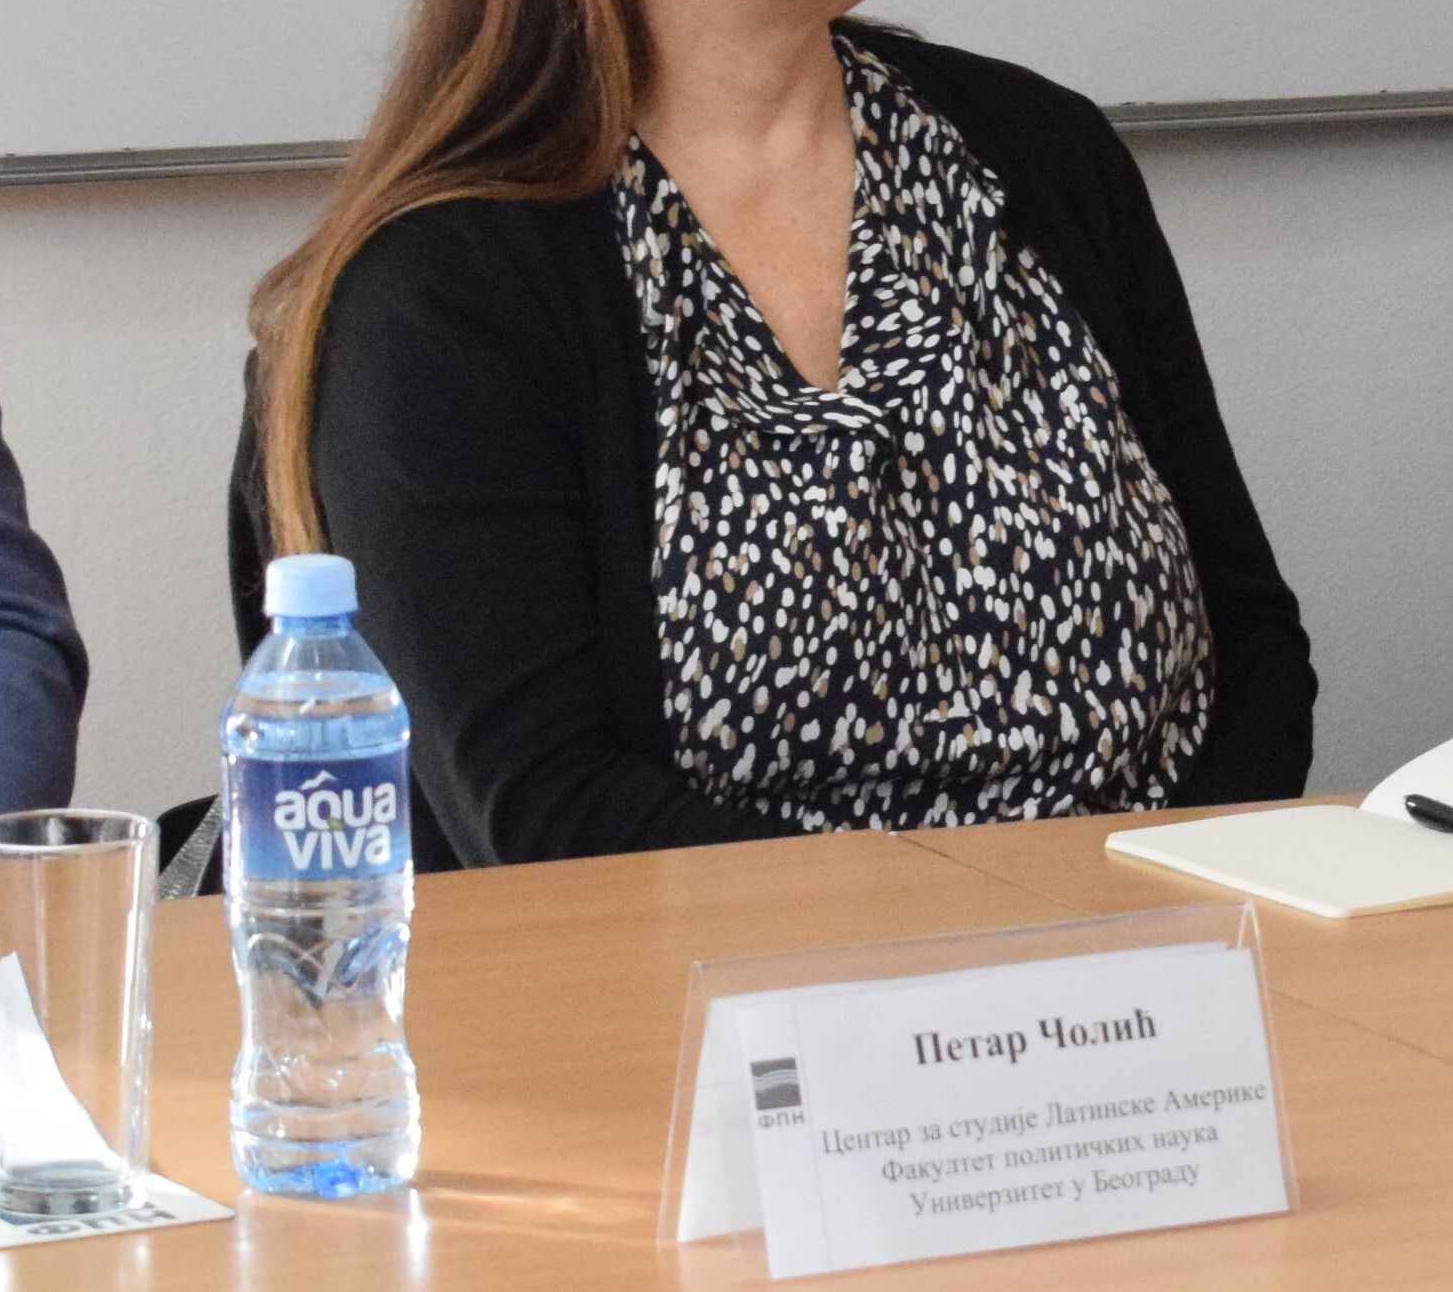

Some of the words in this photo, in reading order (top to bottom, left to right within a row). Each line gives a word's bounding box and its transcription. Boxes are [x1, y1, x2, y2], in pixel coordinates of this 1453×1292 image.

[274, 782, 396, 830] aqua
[282, 823, 391, 871] viva
[913, 1029, 1027, 1064] Петар
[1038, 1008, 1157, 1049] Чолић
[758, 1110, 805, 1129] ФПН
[821, 1127, 911, 1156] Центар
[921, 1123, 942, 1142] за
[949, 1107, 1038, 1141] студије
[1045, 1095, 1156, 1126] Латинске
[1164, 1083, 1266, 1112] Америке
[882, 1154, 995, 1183] Факултет
[1004, 1133, 1145, 1168] политичких
[1153, 1125, 1219, 1151] наука
[910, 1181, 1064, 1216] Универзитет
[1072, 1178, 1086, 1201] у
[1092, 1164, 1199, 1193] Београду
[27, 1203, 177, 1235] ФПН
